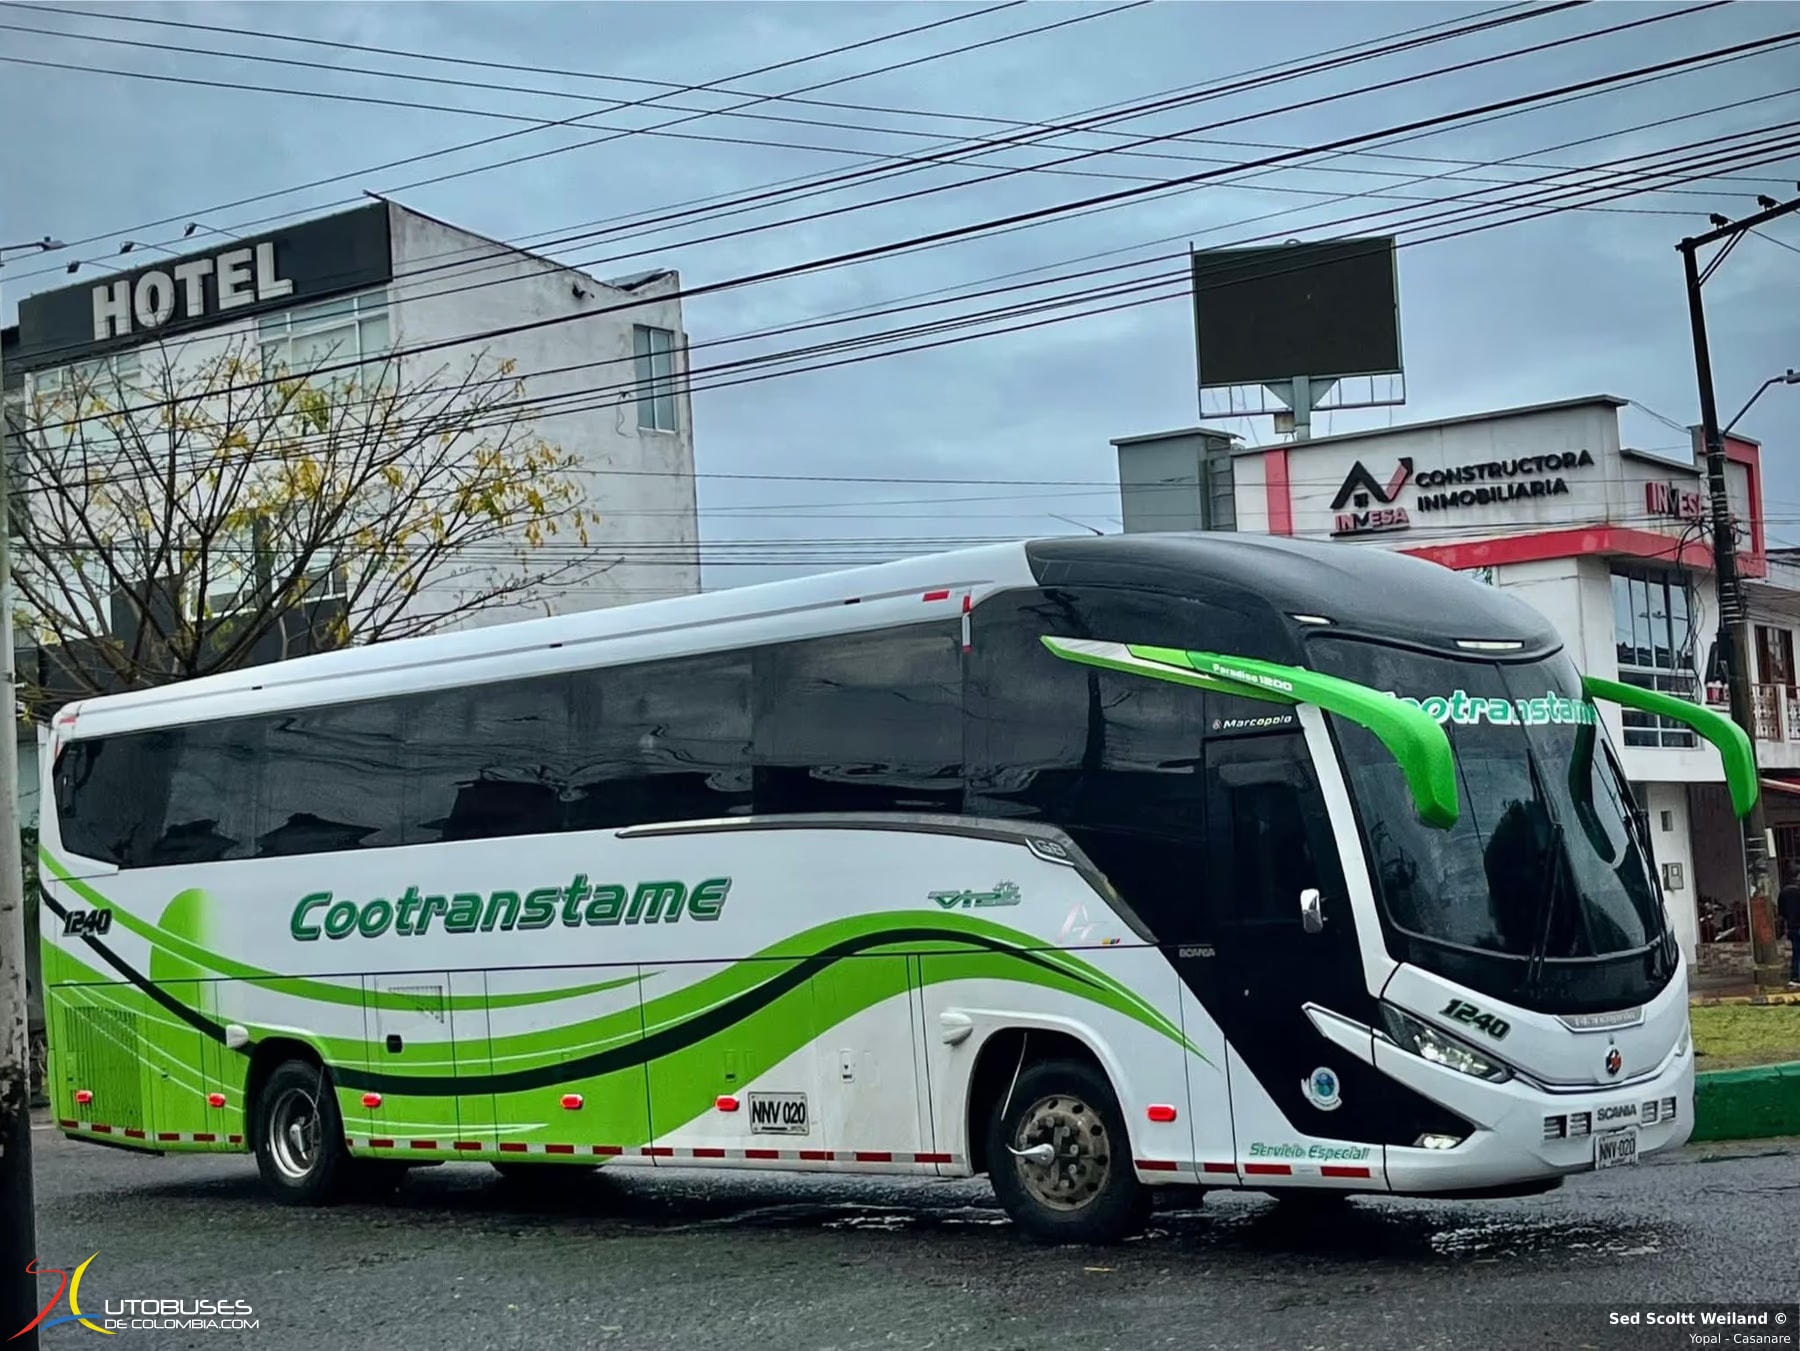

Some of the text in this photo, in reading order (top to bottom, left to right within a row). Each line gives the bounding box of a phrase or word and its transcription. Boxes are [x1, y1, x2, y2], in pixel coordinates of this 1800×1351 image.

[92, 242, 293, 341] HOTEL
[1415, 449, 1595, 488] CONSTRUCTORA
[1417, 477, 1569, 513] INMOBILIARIA
[1645, 481, 1712, 518] INVES
[1335, 507, 1410, 532] INVESA
[1223, 715, 1293, 729] Marcopolo
[62, 909, 112, 937] 1240
[290, 873, 731, 941] Cootranstame
[1439, 998, 1511, 1041] 1240
[752, 1101, 806, 1125] NNV 020
[1597, 1103, 1637, 1121] SCANIA
